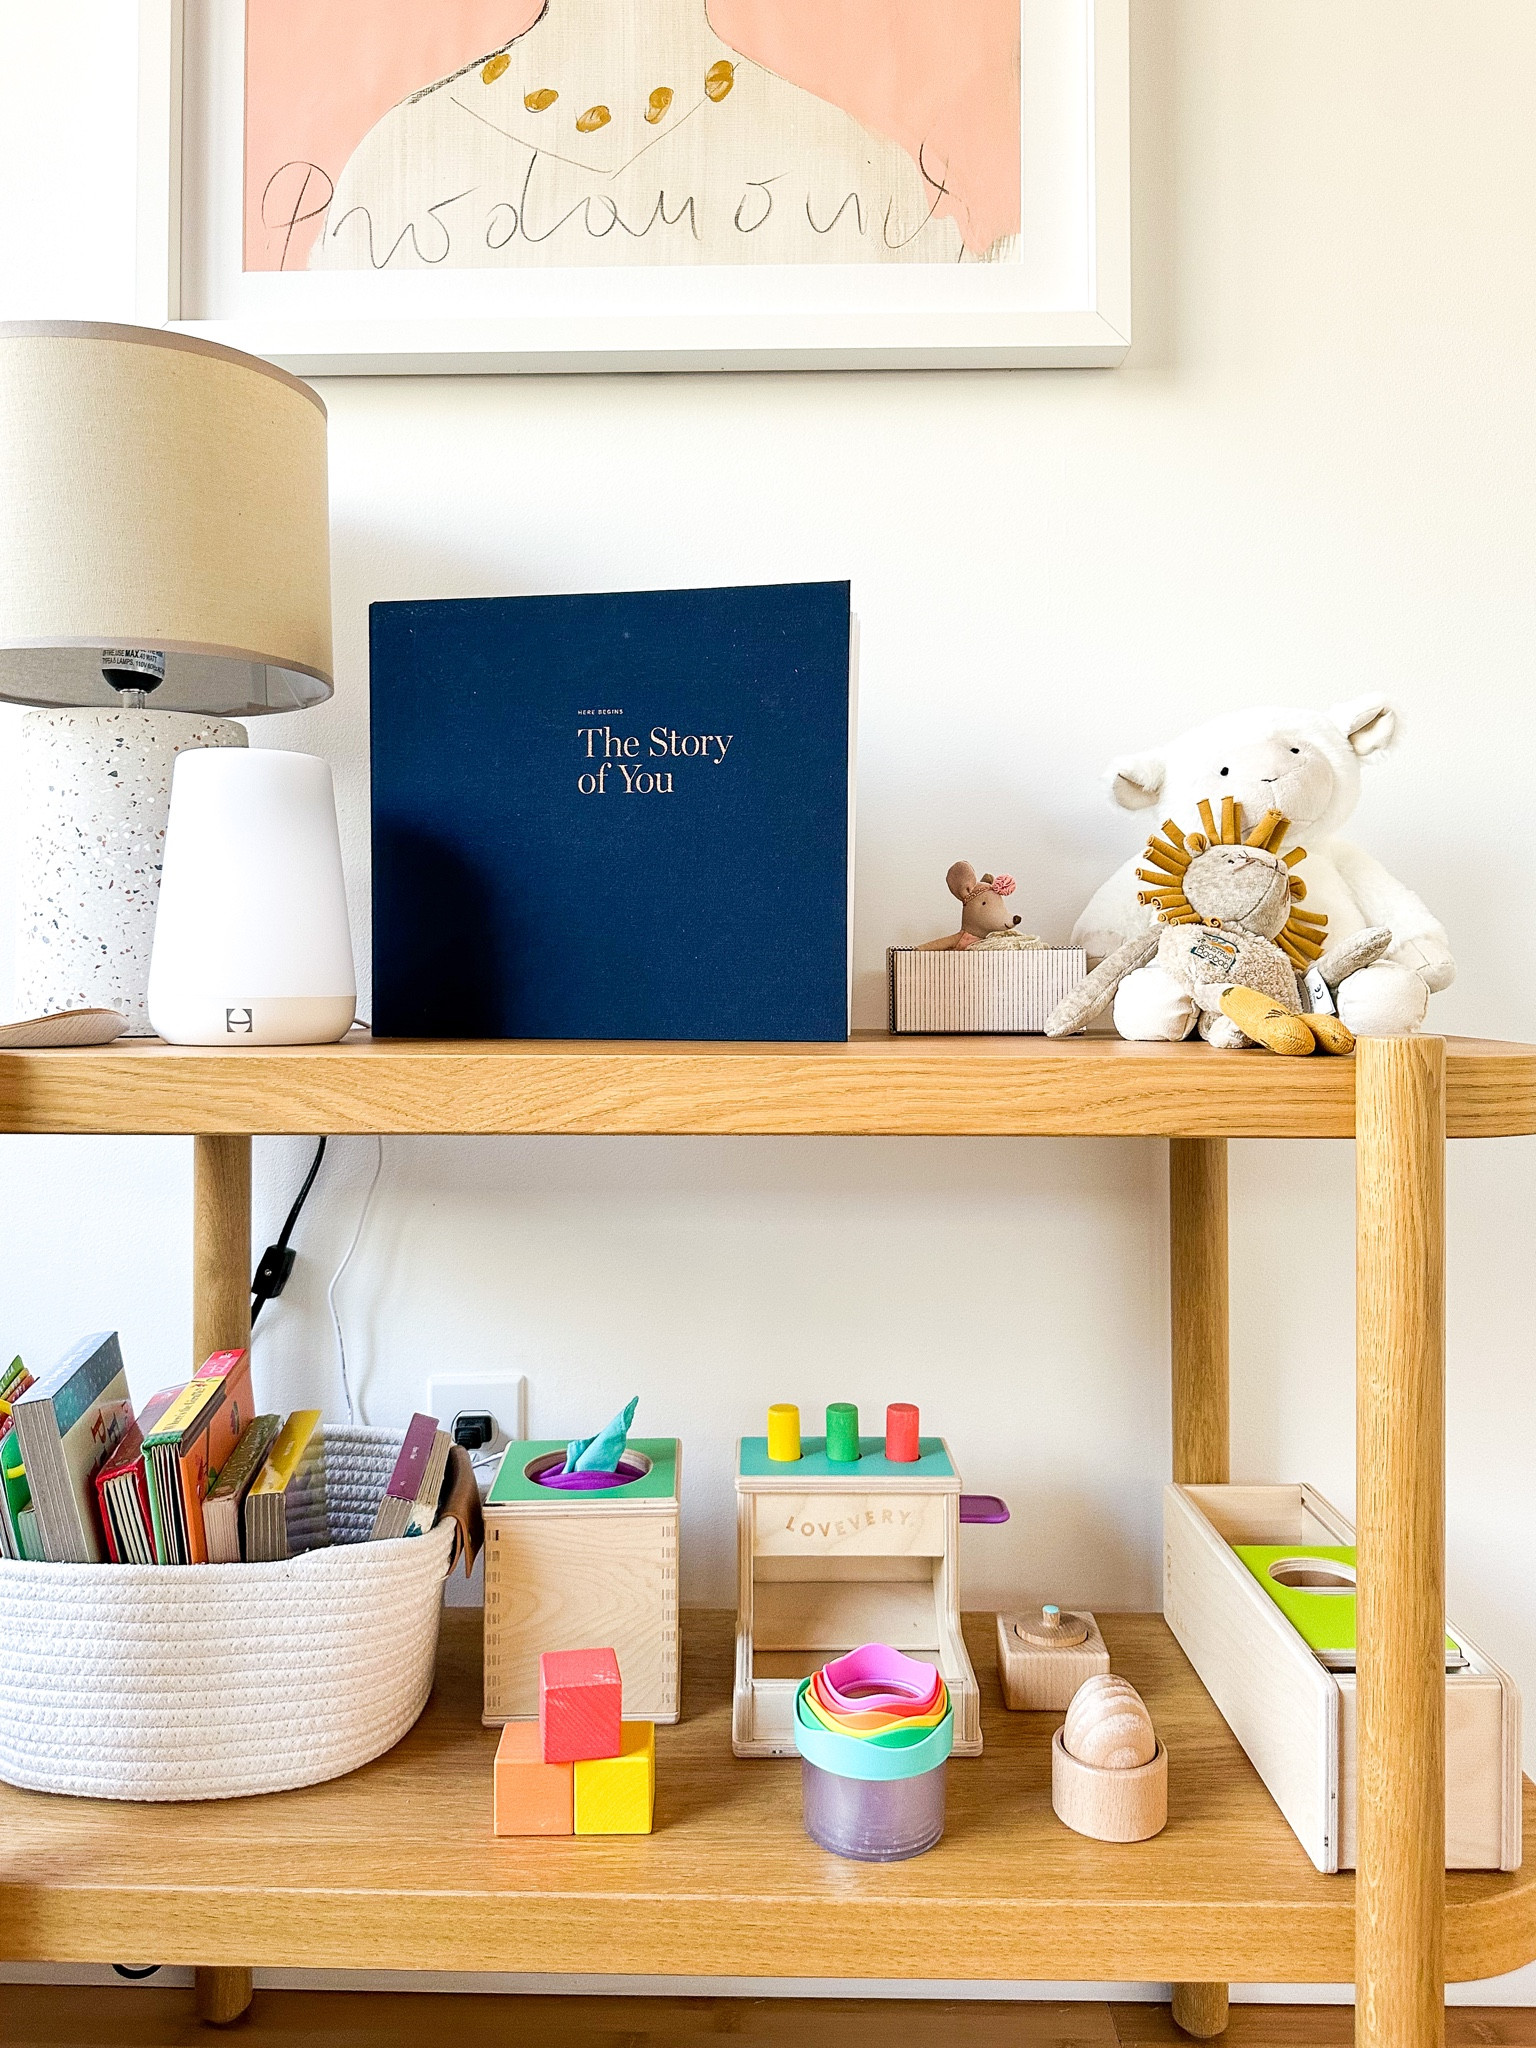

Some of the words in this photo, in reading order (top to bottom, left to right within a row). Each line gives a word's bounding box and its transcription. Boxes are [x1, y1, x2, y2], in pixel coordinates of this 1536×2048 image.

[577, 726, 640, 758] The
[649, 726, 734, 765] Story
[577, 762, 612, 794] of
[617, 764, 674, 794] You
[786, 1509, 911, 1537] LOVEVERY
